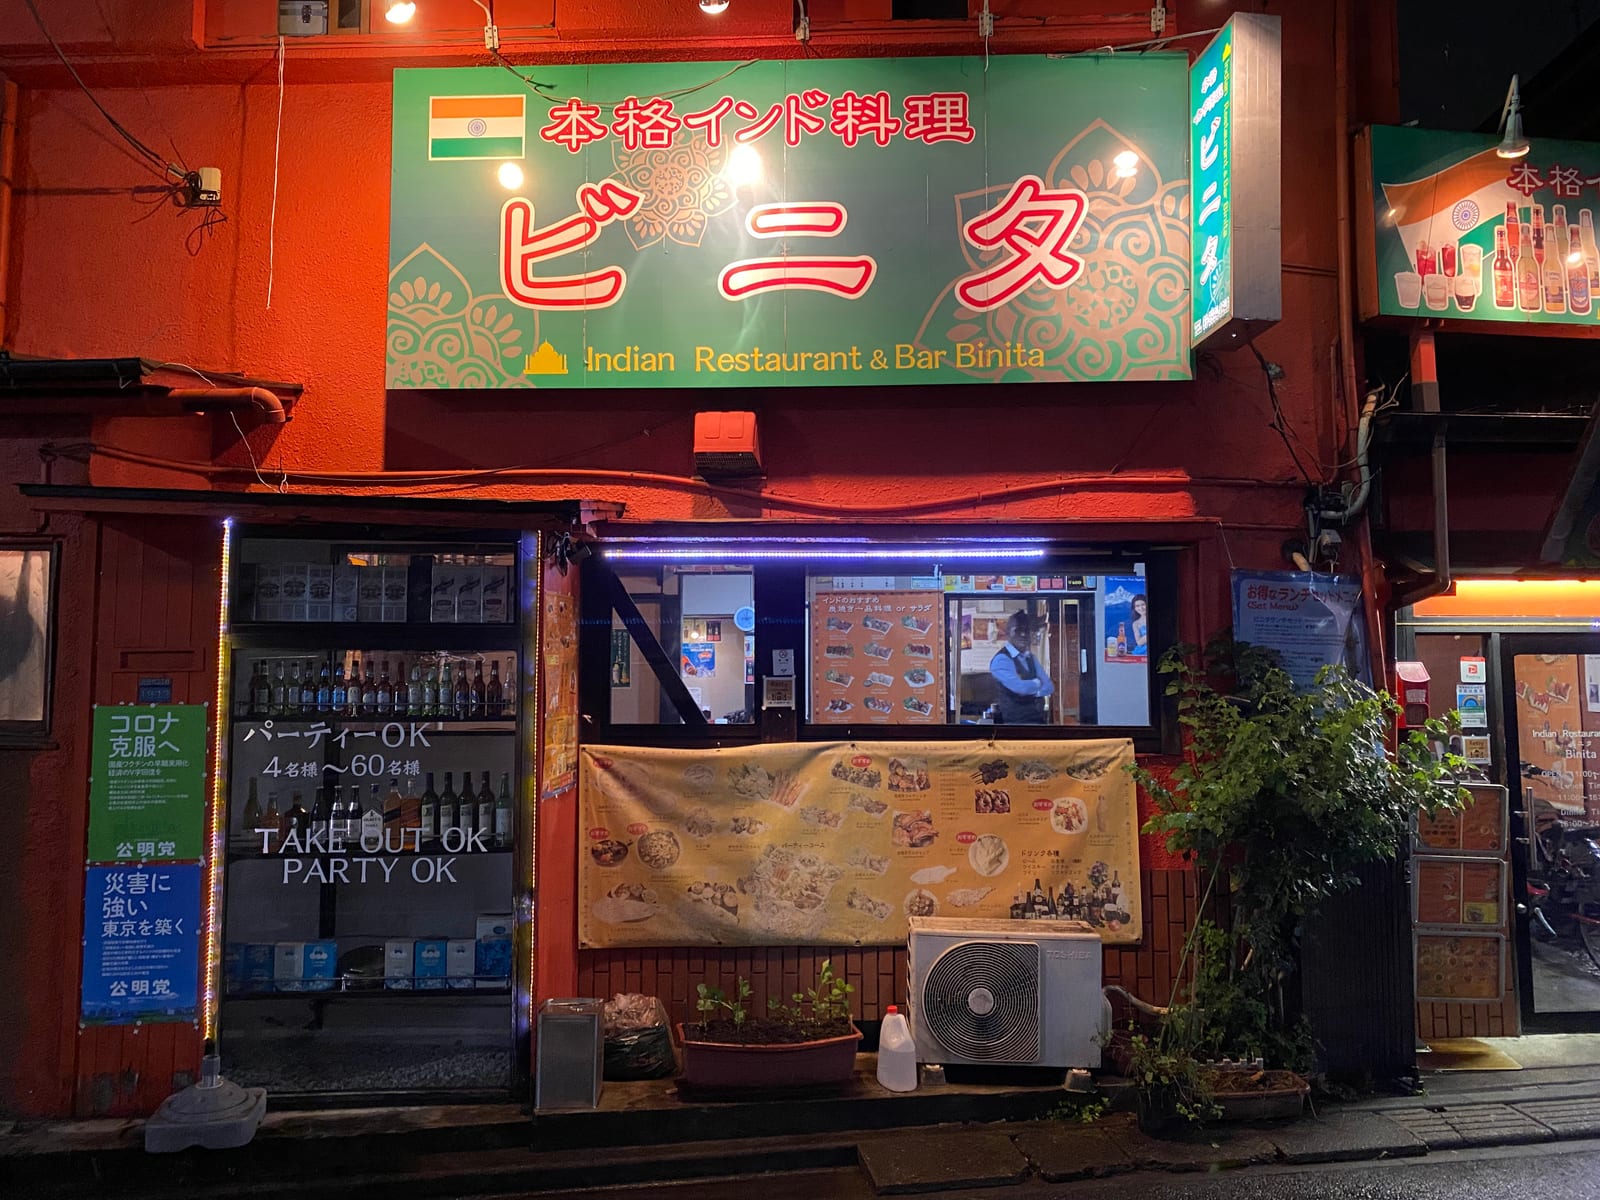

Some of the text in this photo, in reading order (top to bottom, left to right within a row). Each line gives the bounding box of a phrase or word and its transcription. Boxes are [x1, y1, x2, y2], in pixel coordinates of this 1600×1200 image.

[540, 89, 976, 154] 本格インド料理
[1199, 116, 1222, 285] ビニタ
[499, 174, 1090, 313] ビニタ
[587, 341, 1045, 372] Indian Restaurant & Bar Binita
[110, 712, 180, 735] コロナ
[242, 720, 432, 749] パーティーOK
[1532, 730, 1557, 738] Indian
[109, 736, 180, 759] 克服へ
[1566, 749, 1597, 759] Binita
[116, 842, 175, 858] 公明党
[254, 827, 488, 854] TAKE OUT OK
[282, 857, 457, 884] PARTY OK
[103, 872, 171, 896] 災害に
[102, 897, 148, 919] 強い
[101, 918, 184, 938] 東京を築く
[110, 979, 171, 997] 公明党
